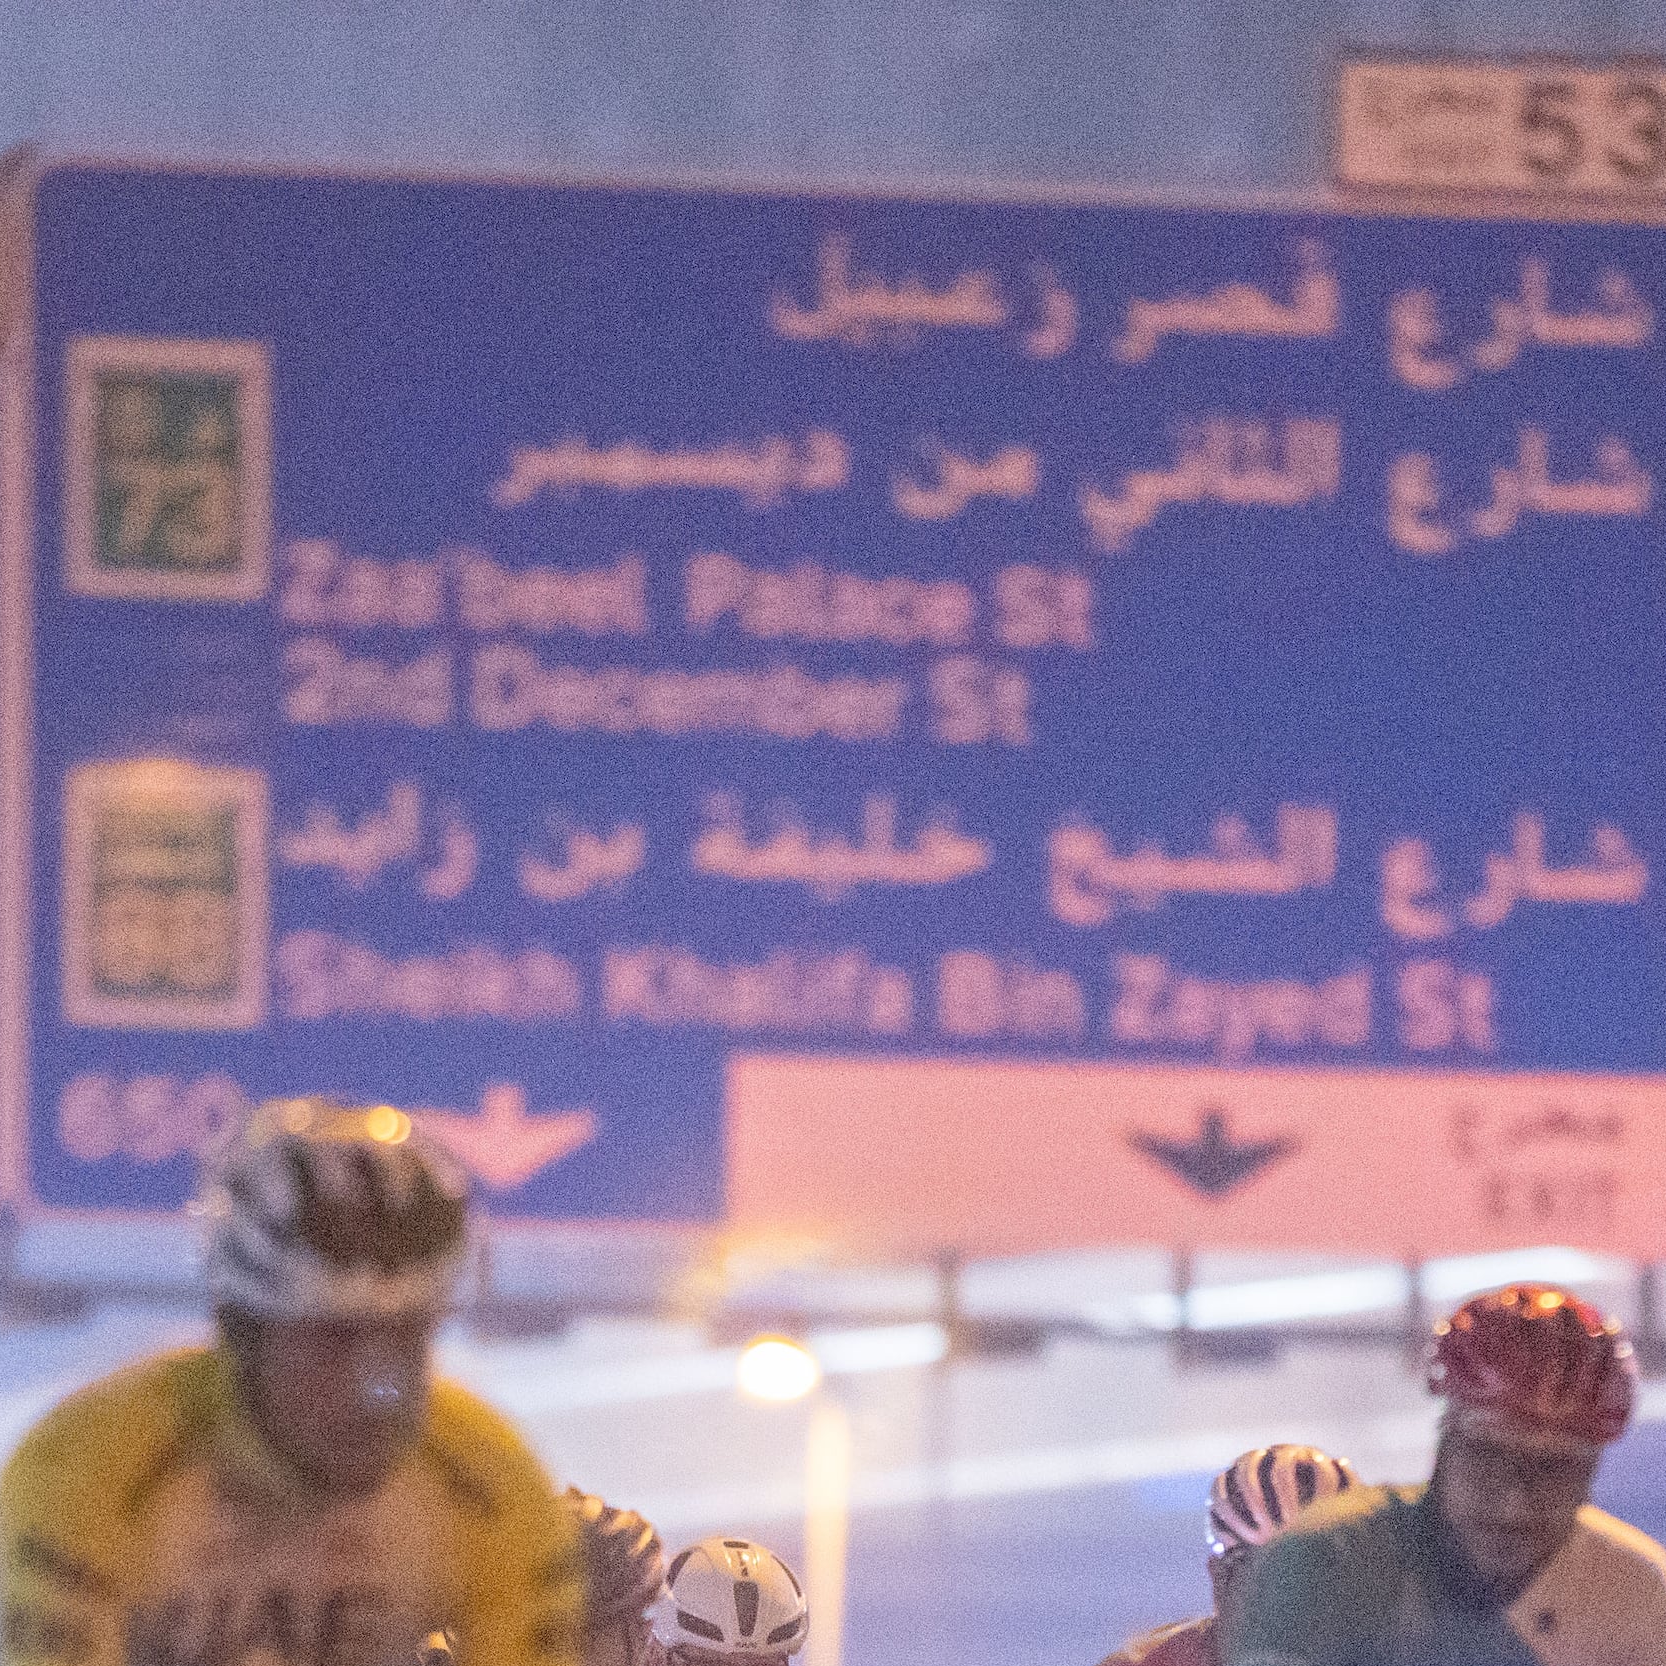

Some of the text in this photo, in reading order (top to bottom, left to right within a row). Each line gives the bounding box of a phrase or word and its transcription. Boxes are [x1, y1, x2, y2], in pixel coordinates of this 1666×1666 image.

[1388, 258, 1653, 388] شارع
[108, 460, 231, 562] 73
[891, 435, 1038, 518] من
[1388, 425, 1653, 555] شارع
[683, 550, 977, 645] Palace
[988, 562, 1093, 650] St
[281, 635, 1035, 745] 2nd December St
[691, 795, 993, 895] خليفة
[1045, 805, 1341, 925] الشيخ
[1383, 810, 1645, 938] شارع
[275, 930, 1501, 1065] Sheikh Khalifa Bin Zayed St
